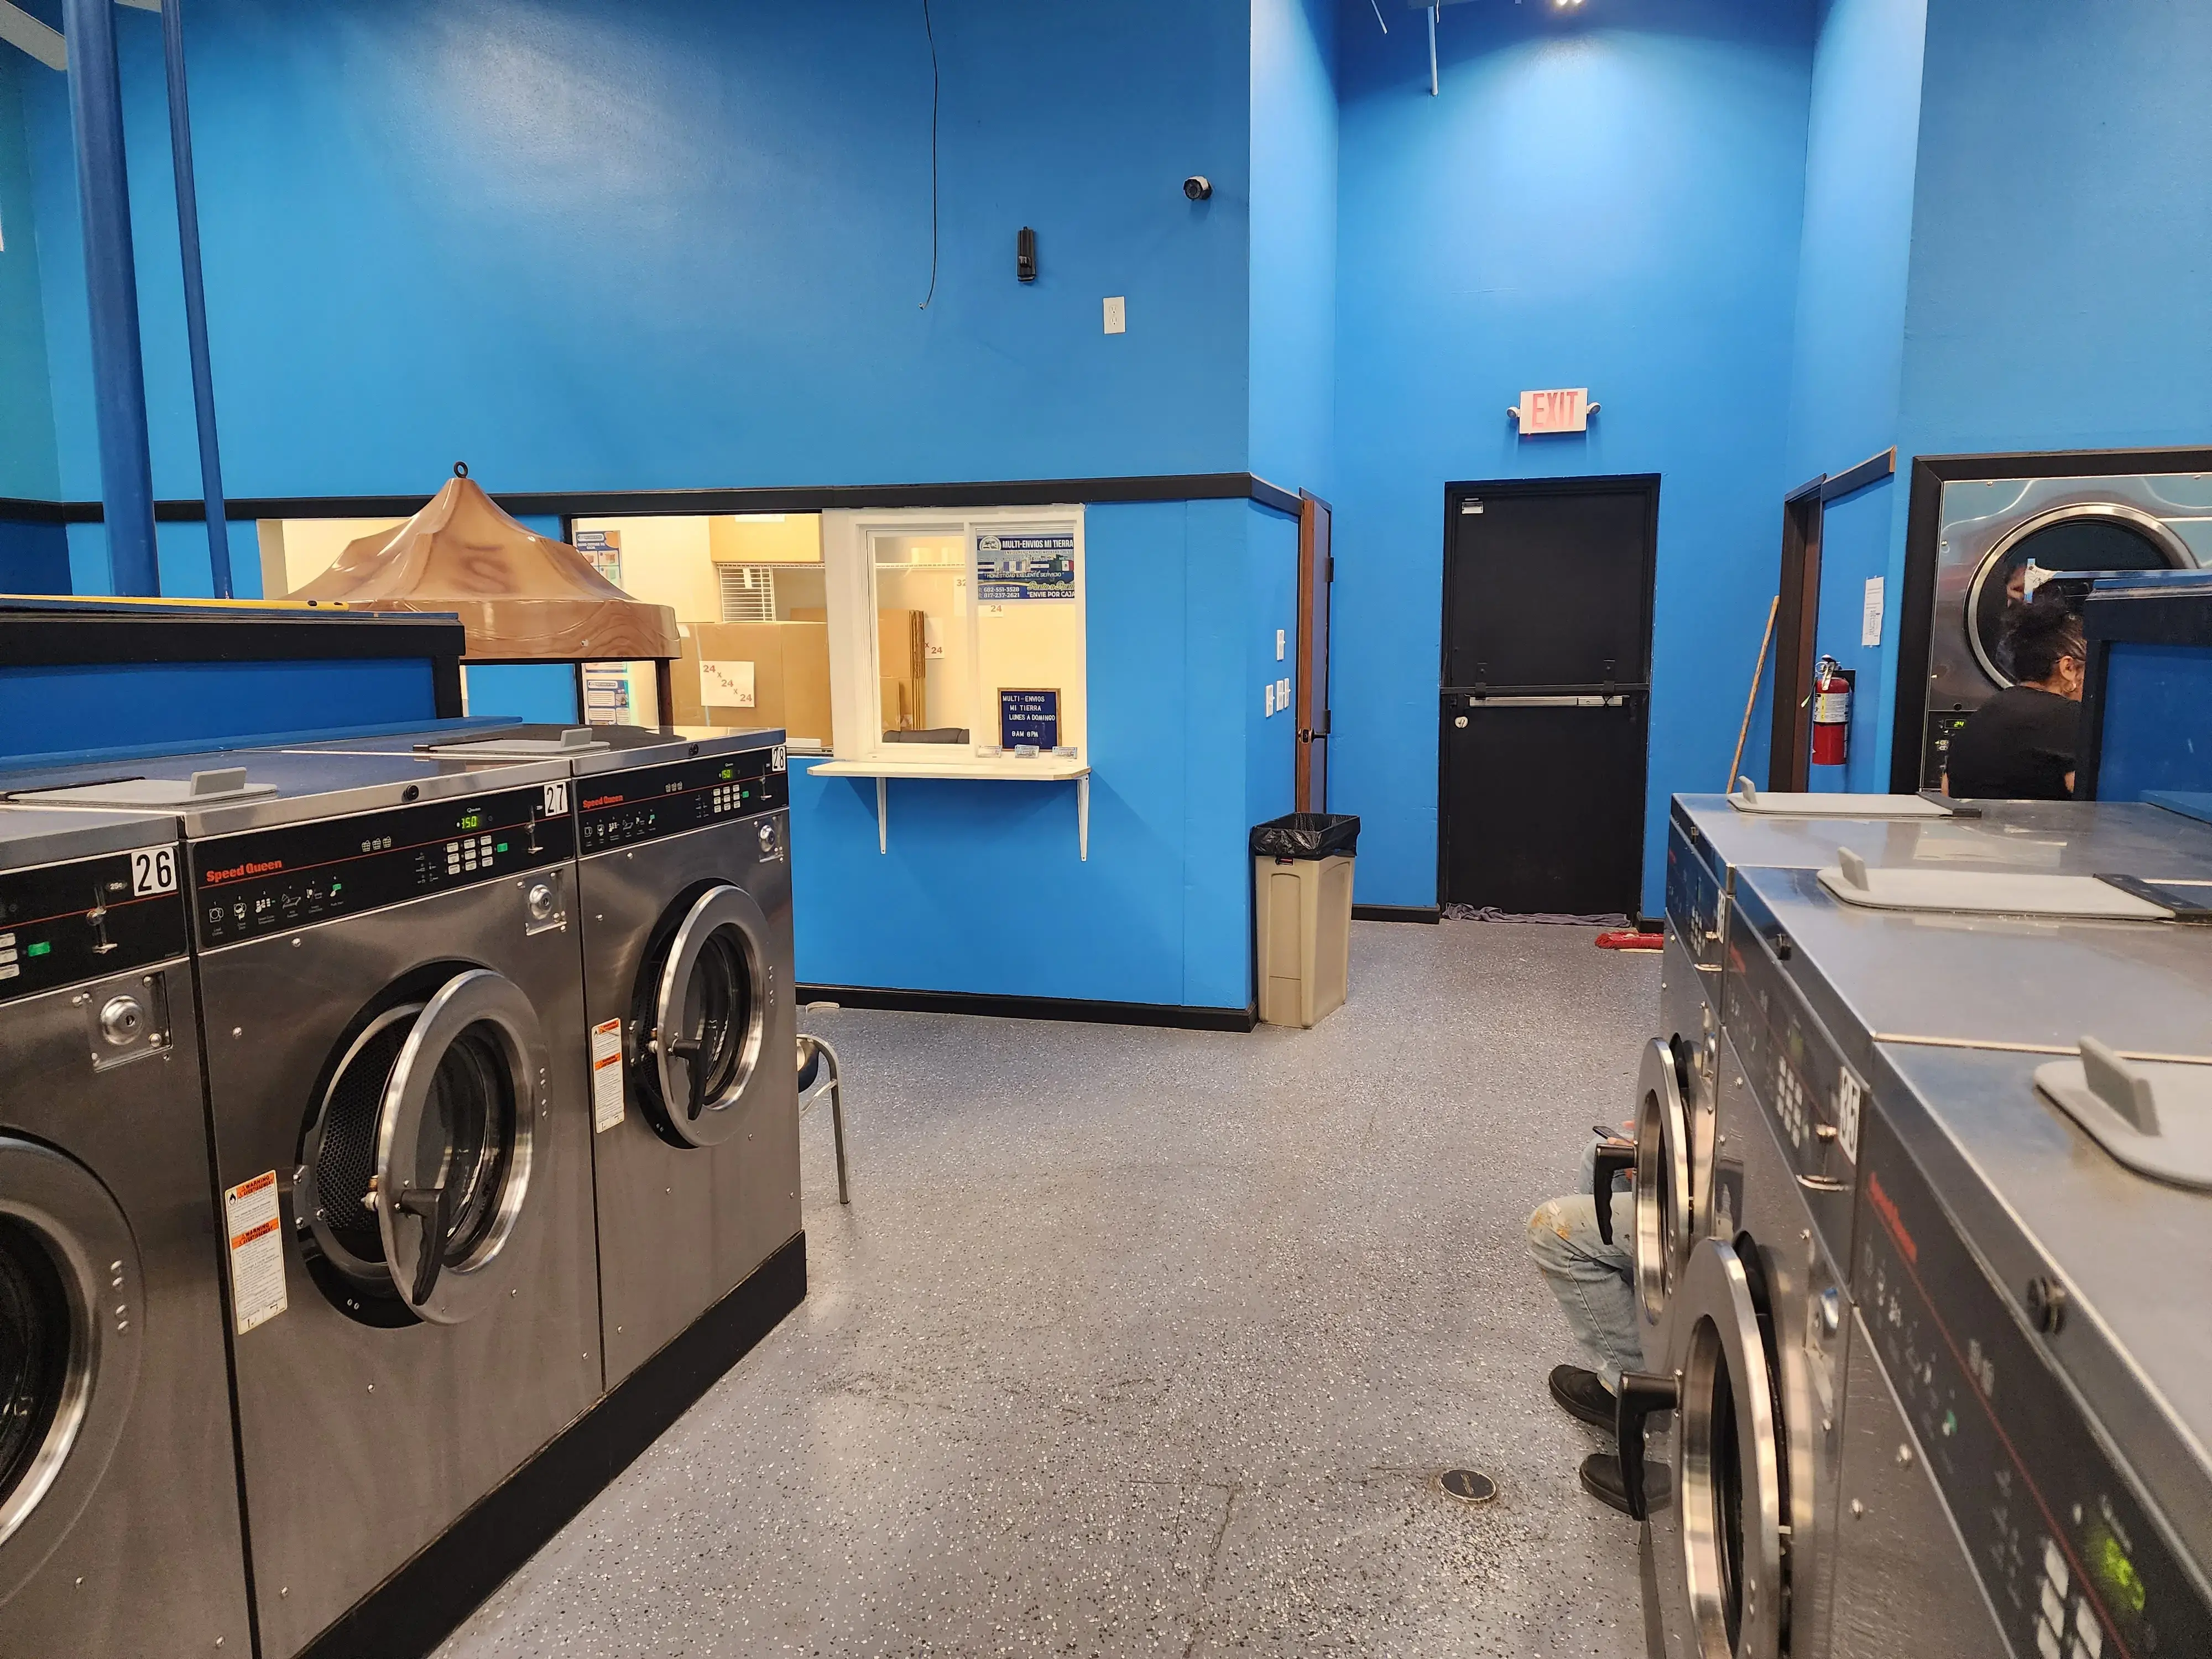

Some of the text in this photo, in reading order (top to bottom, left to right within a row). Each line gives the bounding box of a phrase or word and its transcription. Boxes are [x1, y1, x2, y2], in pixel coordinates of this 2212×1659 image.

[1532, 391, 1578, 429] EXIT
[1002, 539, 1074, 549] MULTI-ENVIOS MI TIERRA
[703, 665, 716, 673] 24
[721, 679, 734, 687] 24
[740, 693, 753, 702] 24
[773, 748, 784, 769] 28
[546, 784, 564, 813] 27
[136, 851, 172, 893] 26
[206, 860, 282, 883] Speed Queen
[245, 1175, 270, 1188] WARNING
